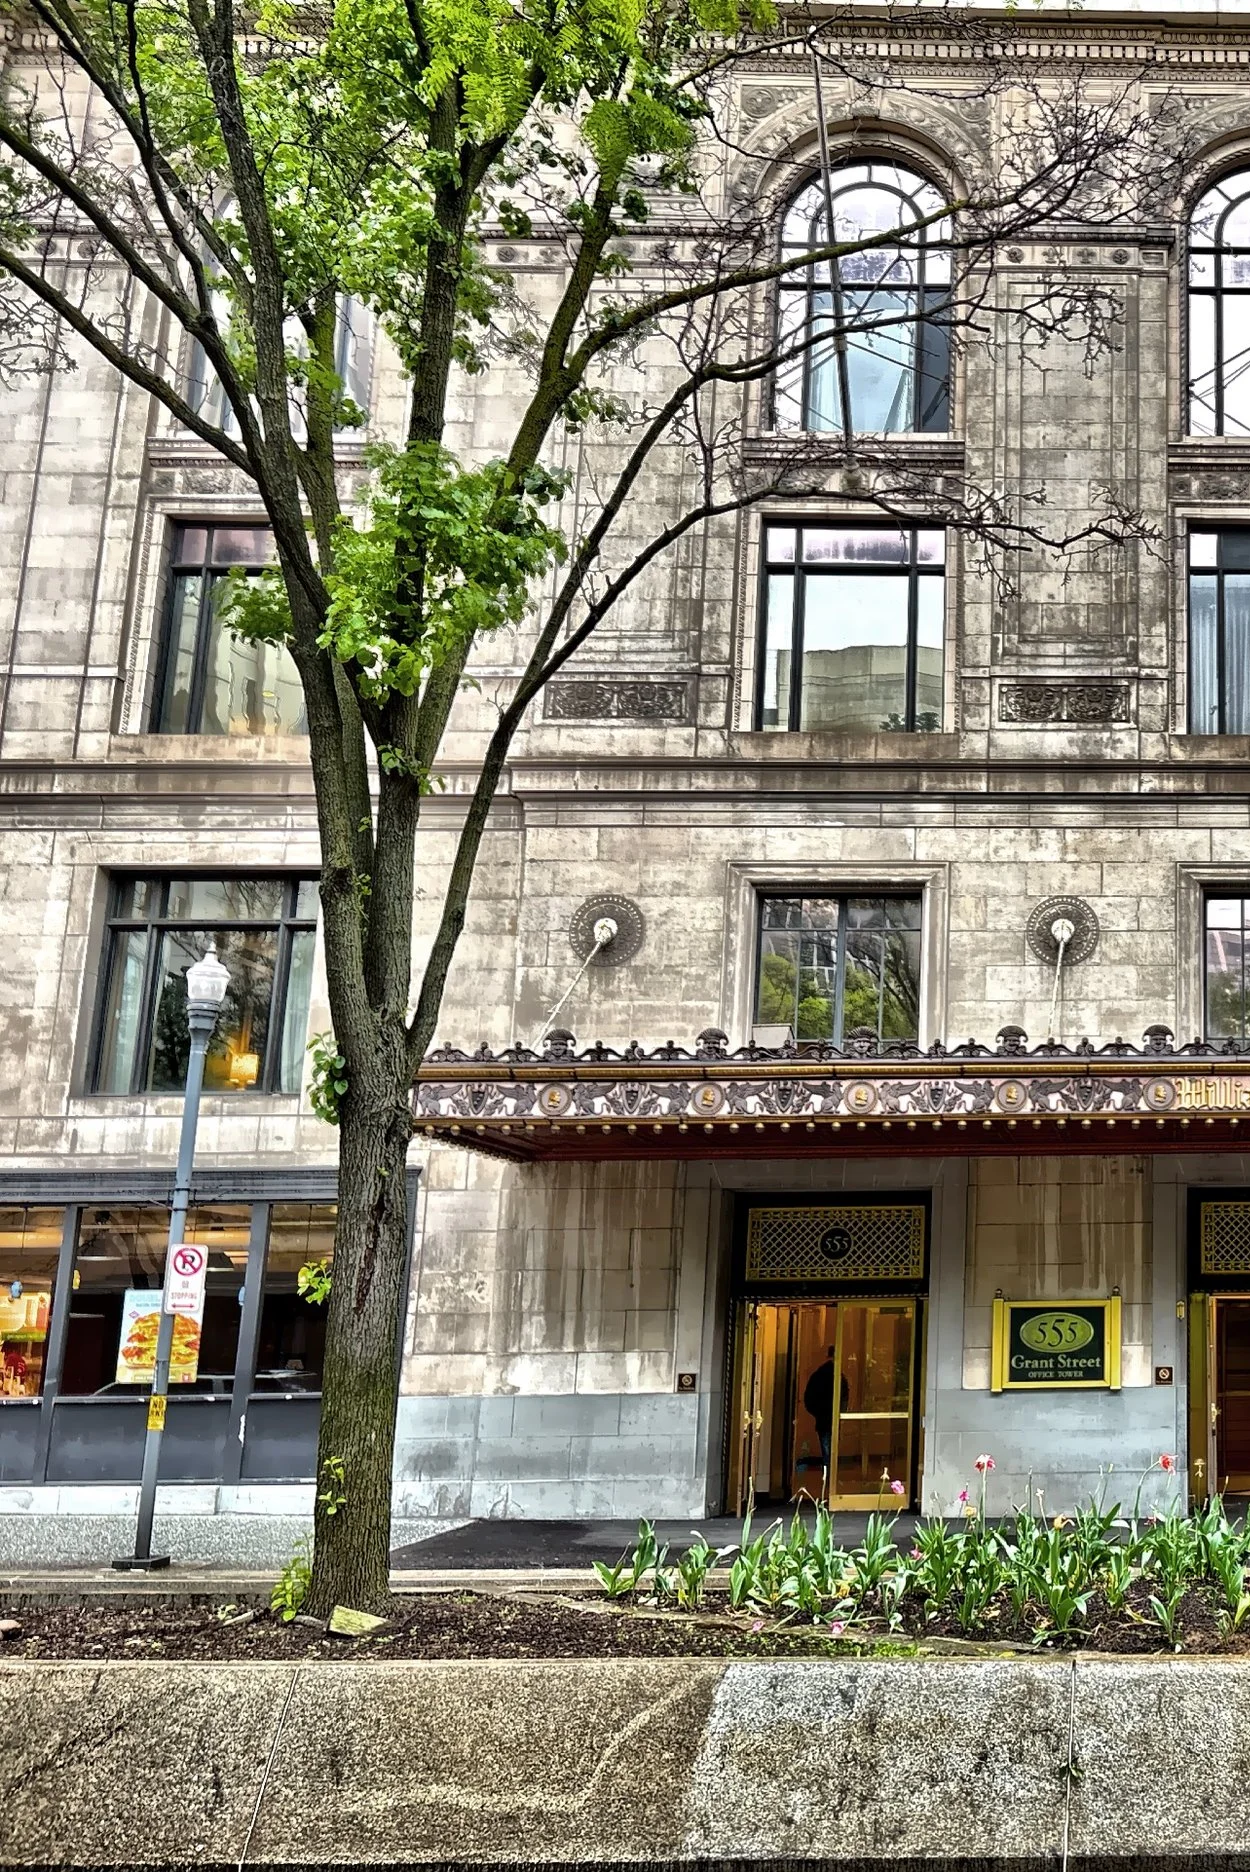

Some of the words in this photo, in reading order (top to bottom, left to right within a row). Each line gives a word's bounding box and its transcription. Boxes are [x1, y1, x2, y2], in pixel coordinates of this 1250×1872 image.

[824, 1236, 849, 1252] 555
[170, 1291, 198, 1300] STOPPING
[1034, 1318, 1078, 1347] 555
[1011, 1354, 1054, 1369] Grant
[1057, 1353, 1101, 1368] Street
[1058, 1370, 1084, 1378] TOWER
